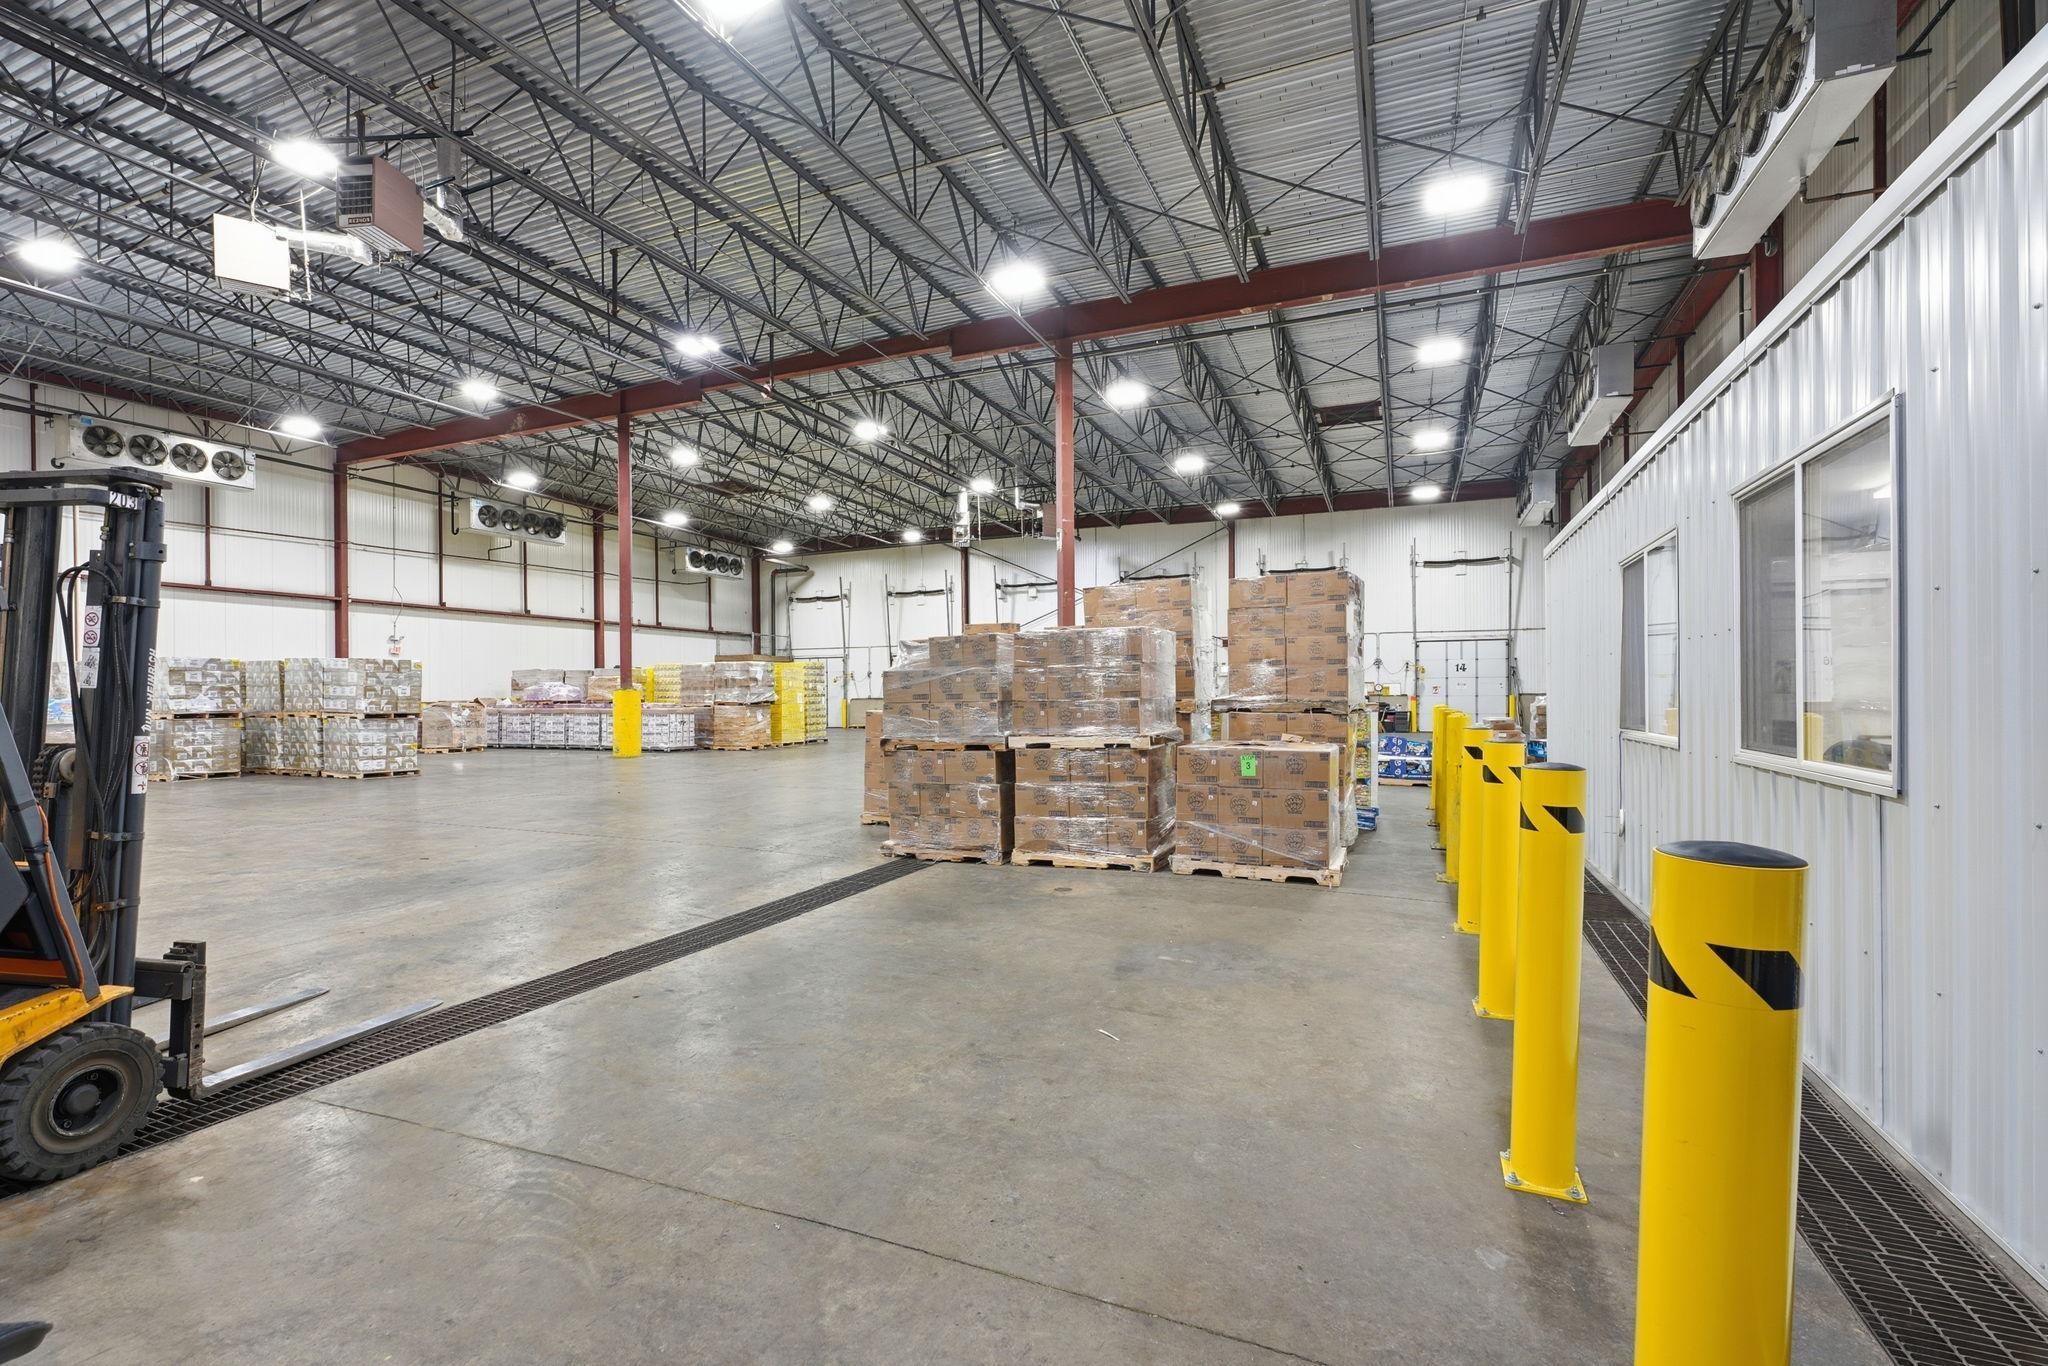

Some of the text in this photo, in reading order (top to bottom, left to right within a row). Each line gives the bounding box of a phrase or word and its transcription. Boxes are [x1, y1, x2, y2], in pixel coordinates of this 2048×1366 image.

[111, 491, 136, 510] 203
[1455, 663, 1467, 672] 14
[141, 648, 157, 732] JUNHEINRICH
[1246, 761, 1251, 770] 3
